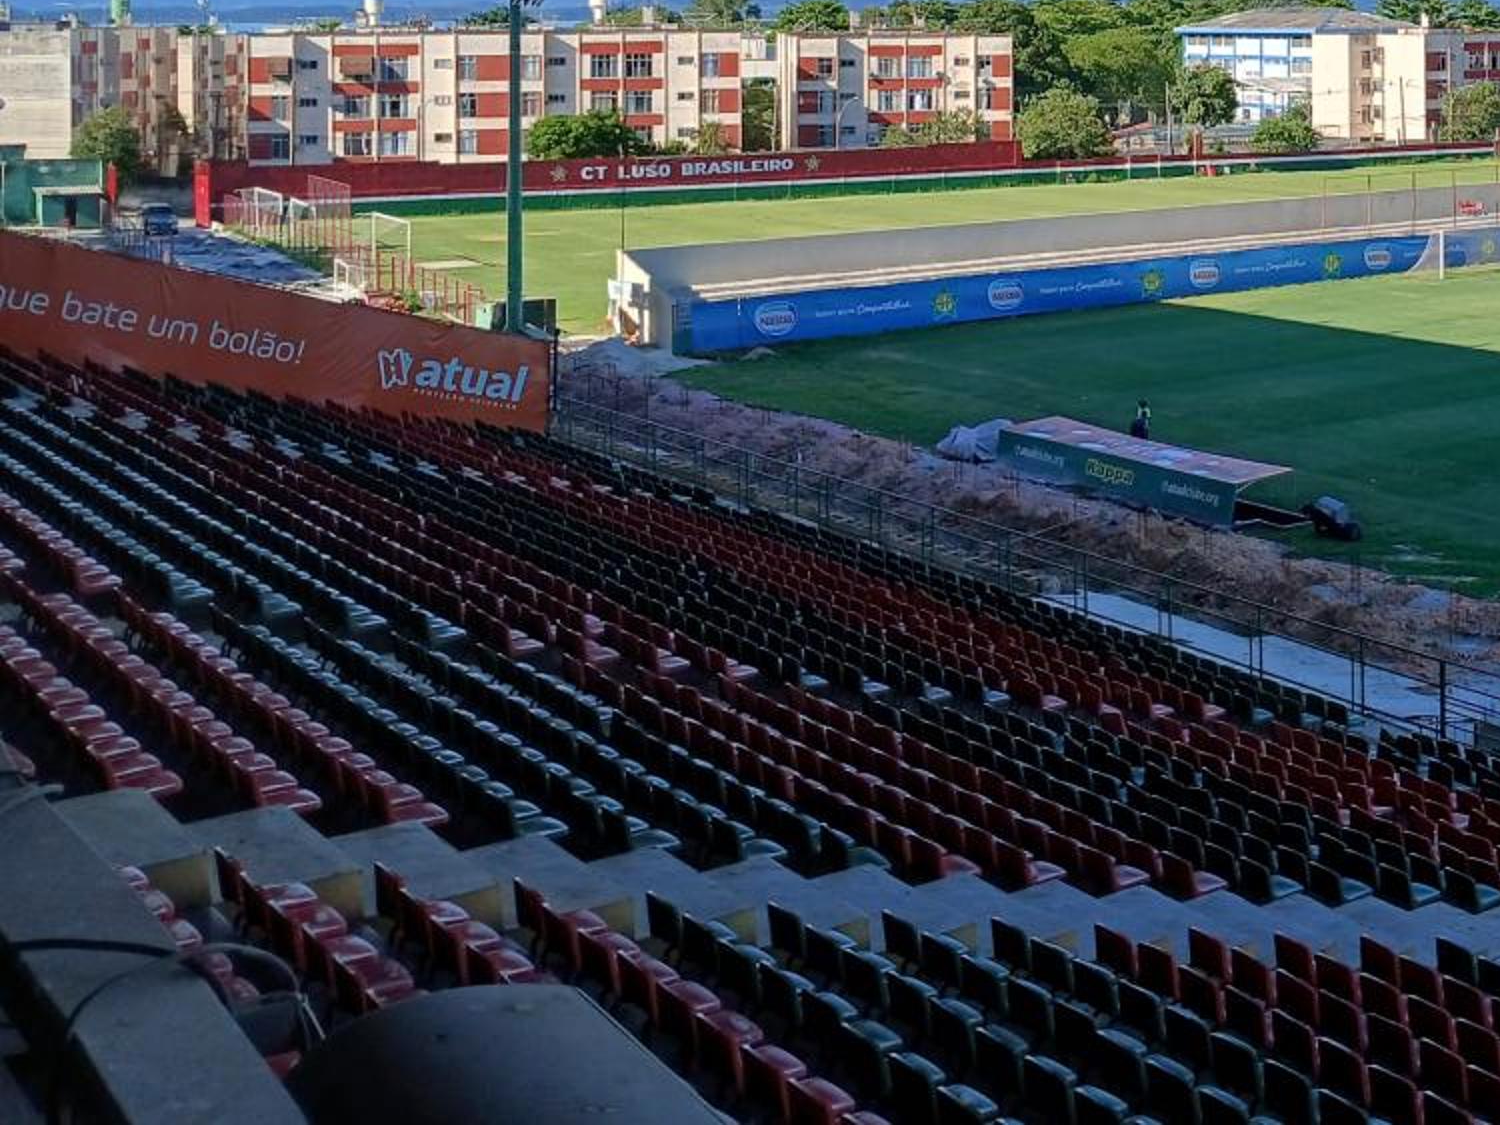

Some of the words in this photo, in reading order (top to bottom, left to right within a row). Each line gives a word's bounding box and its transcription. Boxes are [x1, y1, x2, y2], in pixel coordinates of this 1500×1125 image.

[580, 166, 609, 180] CT
[618, 163, 672, 179] LUSO
[681, 158, 795, 176] BRASILEIRO
[62, 290, 138, 331] bate
[147, 315, 198, 346] um
[209, 321, 306, 365] bolão!
[415, 356, 529, 403] atual
